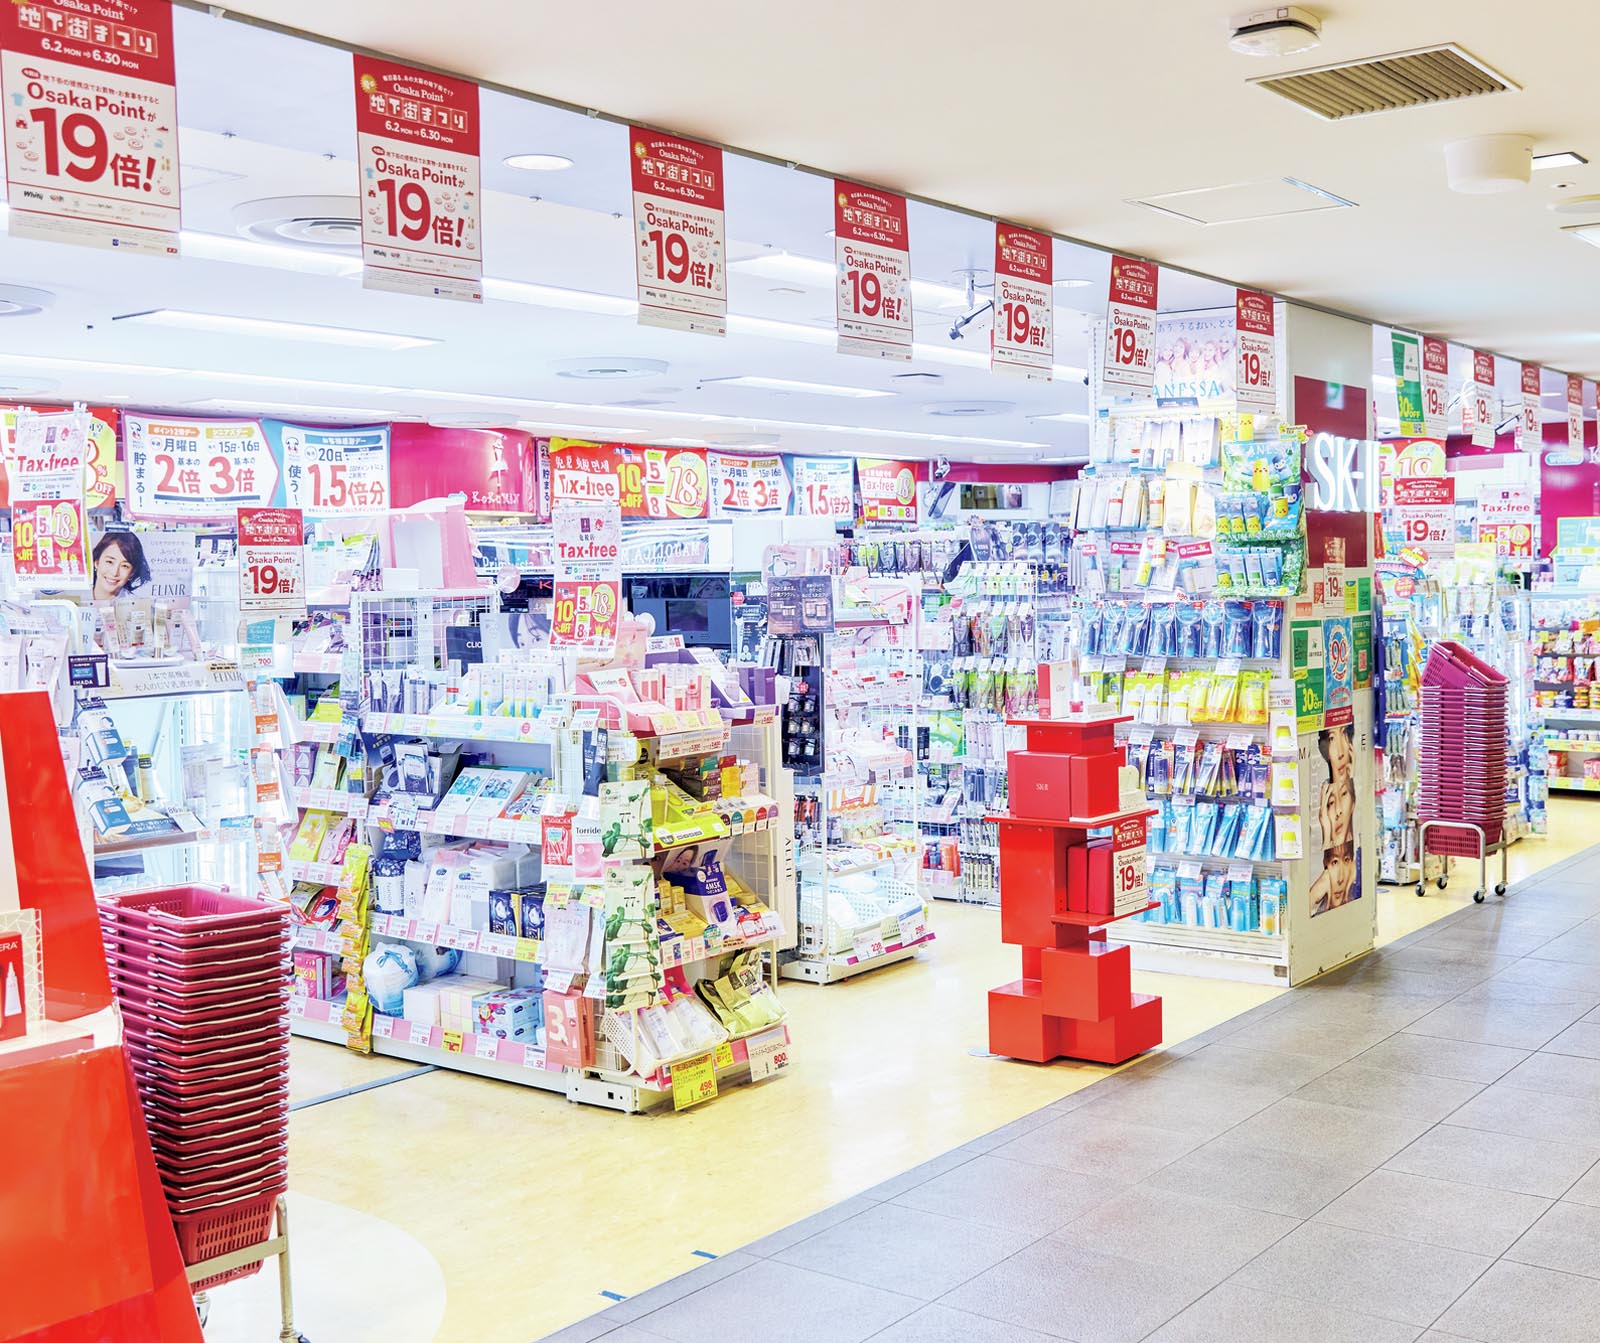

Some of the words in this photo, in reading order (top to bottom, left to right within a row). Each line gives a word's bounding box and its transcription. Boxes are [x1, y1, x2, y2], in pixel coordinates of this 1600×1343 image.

[92, 3, 125, 21] Point
[20, 6, 152, 53] 地下街まつり
[41, 38, 62, 53] 6.2
[92, 49, 120, 65] 6.30
[26, 81, 93, 110] Osaka
[393, 83, 420, 97] Osaka
[421, 89, 444, 102] Point
[370, 94, 464, 129] 地下街まつり
[385, 120, 400, 133] 6.2
[420, 128, 440, 141] 6.30
[30, 107, 157, 192] 19倍!
[375, 157, 420, 180] Osaka
[642, 159, 712, 187] 地下街まつり
[653, 180, 666, 191] 6.2
[680, 187, 695, 197] 6.30
[377, 179, 464, 248] 19倍!
[647, 212, 681, 231] Osaka
[843, 207, 899, 232] 地下街まつり
[852, 227, 863, 236] 6.2
[873, 231, 886, 241] 6.30
[648, 230, 714, 289] 19倍!
[846, 255, 875, 271] Osaka
[847, 270, 902, 321] 19倍!
[1003, 288, 1025, 303] Osaka
[1003, 302, 1046, 347] 19倍!
[1114, 315, 1133, 328] Osaka
[1114, 327, 1149, 367] 19倍!
[163, 439, 197, 452] 月曜日
[318, 447, 343, 462] 20日
[17, 454, 79, 473] Tax-free
[650, 462, 660, 479] 5
[155, 455, 201, 494] 2倍
[208, 456, 255, 494] 3倍
[616, 463, 641, 493] 10
[862, 478, 895, 491] Tax-free
[95, 481, 113, 494] OFF
[307, 464, 385, 507] 1.5倍分
[667, 466, 698, 505] 18
[723, 478, 749, 506] 2倍
[753, 480, 779, 507] 3倍
[650, 497, 660, 515] 8
[806, 484, 850, 515] 1.5倍分
[1481, 503, 1530, 513] Tax-free
[15, 522, 34, 547] 10
[1402, 520, 1446, 542] 19倍!
[40, 550, 48, 565] 8
[558, 541, 617, 558] Tax-free
[247, 556, 272, 564] Osaka
[151, 583, 186, 596] ELIXIR
[248, 565, 295, 594] 19倍!
[556, 600, 574, 622] 10
[579, 597, 586, 611] 5
[577, 624, 585, 637] 8
[213, 670, 243, 682] ELIXIR
[1313, 700, 1323, 709] OFF
[773, 1052, 786, 1064] 800
[699, 1080, 713, 1092] 498
